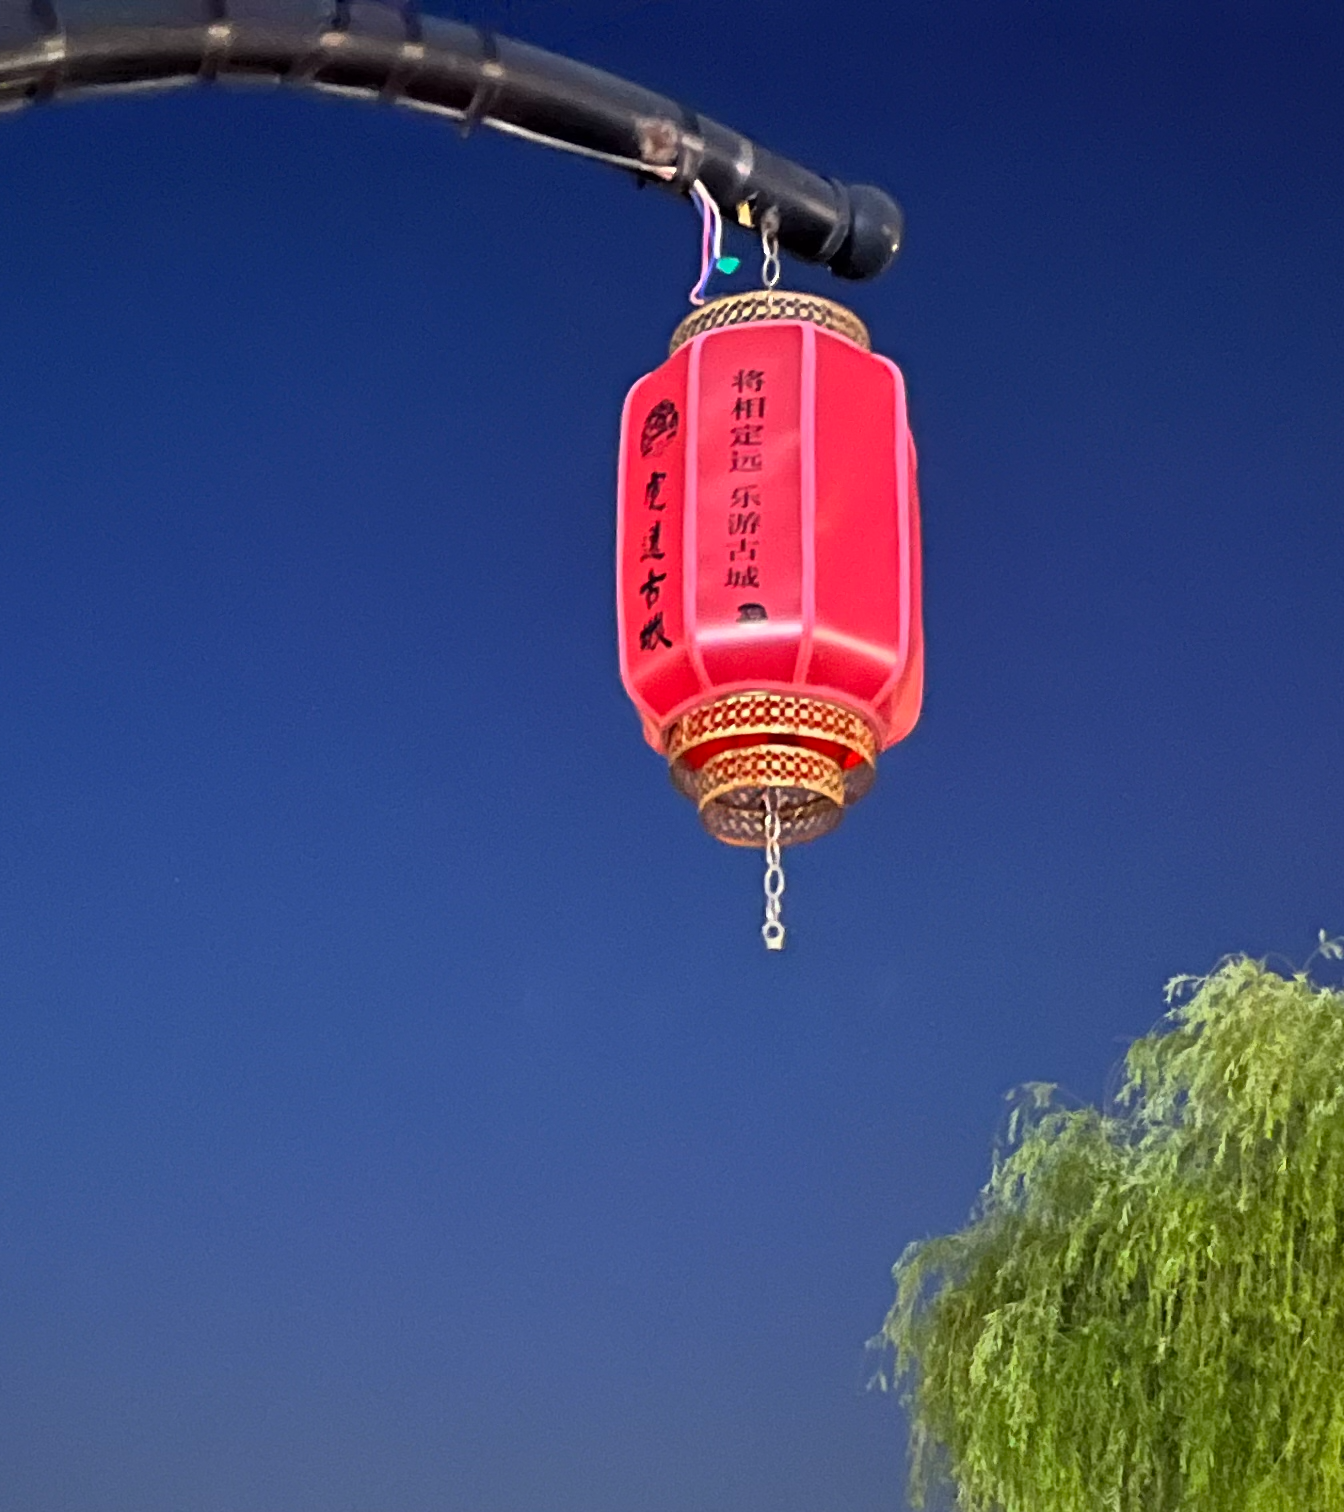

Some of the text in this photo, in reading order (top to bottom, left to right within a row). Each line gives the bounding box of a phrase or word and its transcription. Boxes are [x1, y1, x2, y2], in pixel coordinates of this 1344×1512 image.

[724, 369, 766, 588] 将相定远 乐游古城
